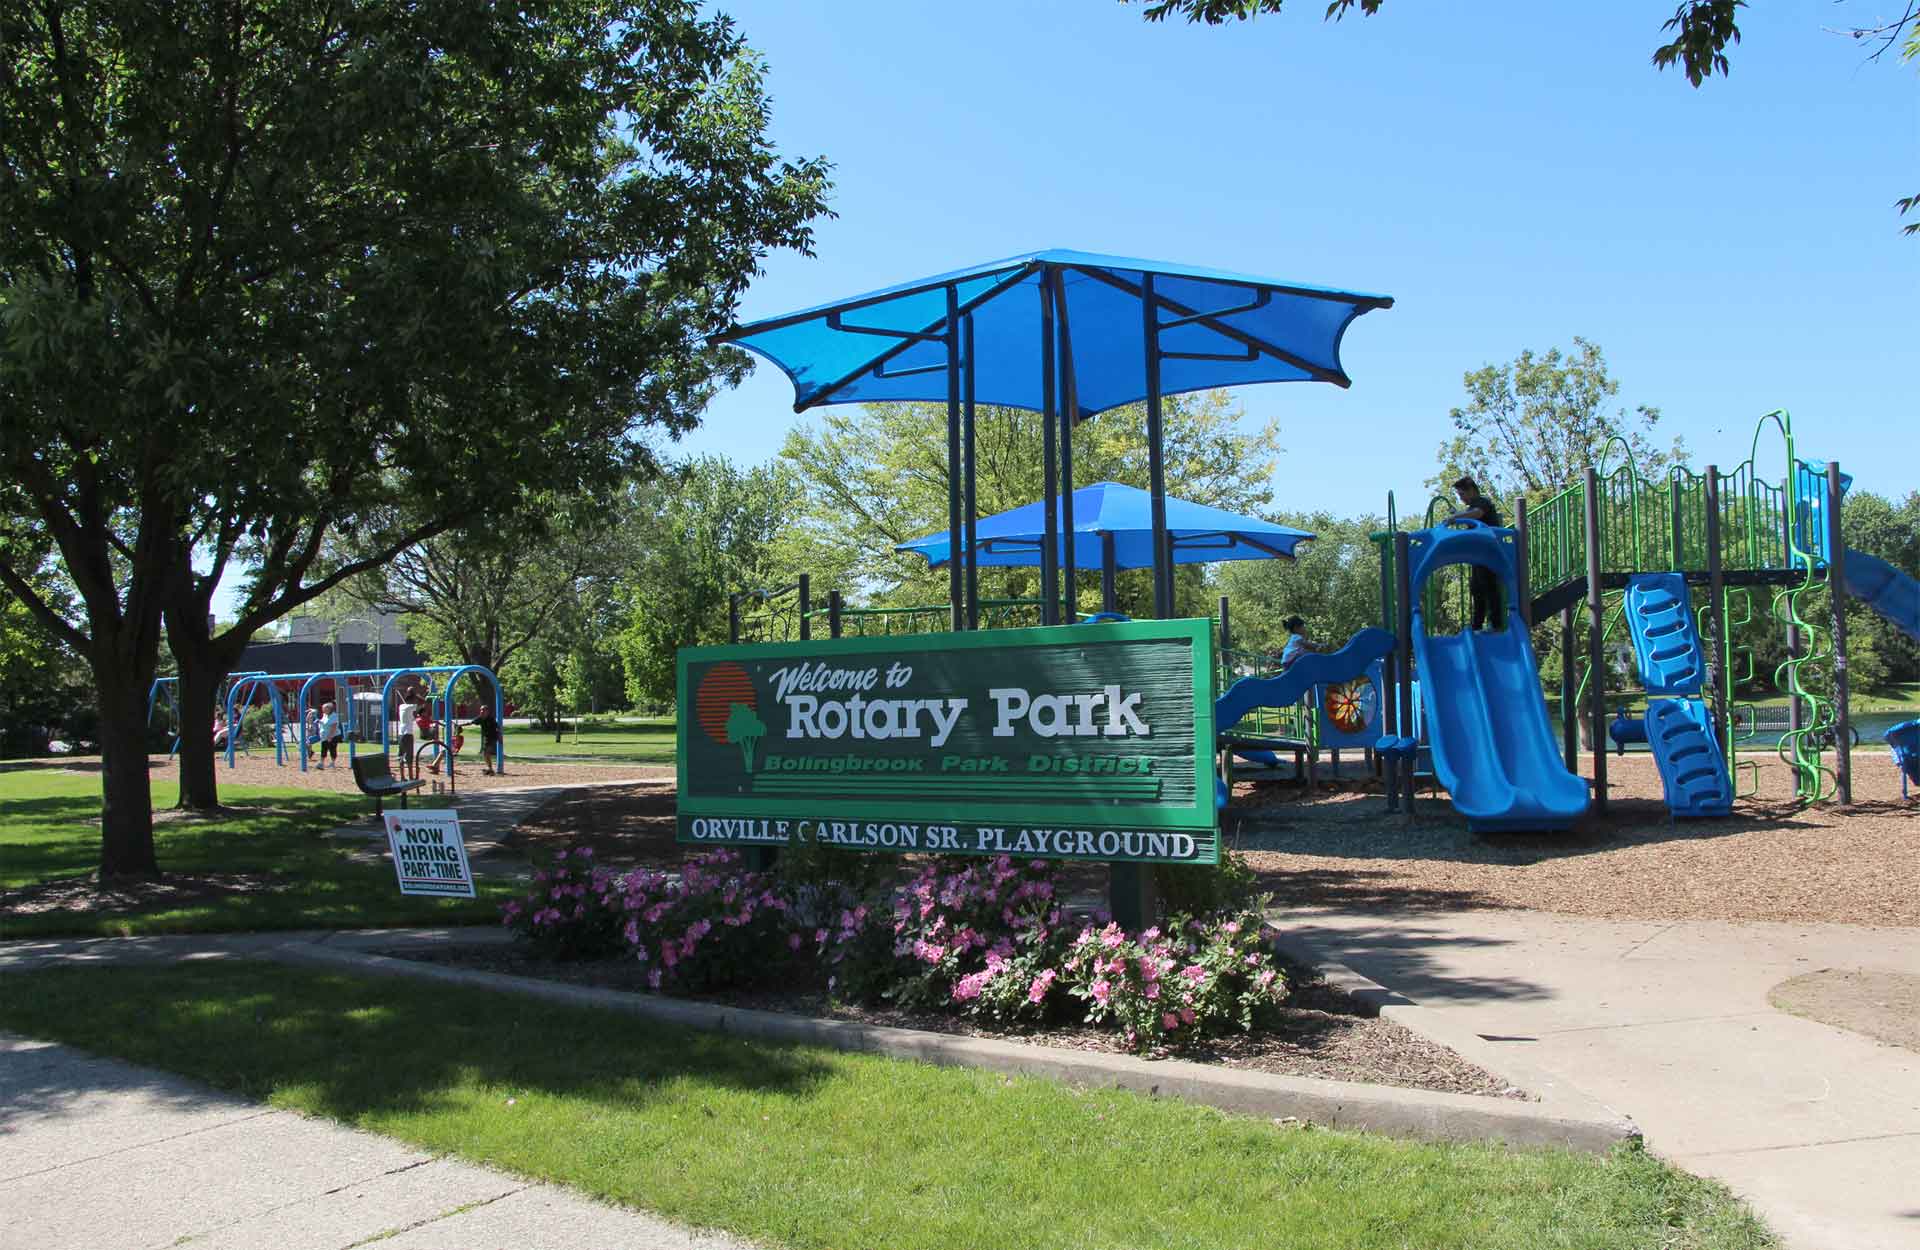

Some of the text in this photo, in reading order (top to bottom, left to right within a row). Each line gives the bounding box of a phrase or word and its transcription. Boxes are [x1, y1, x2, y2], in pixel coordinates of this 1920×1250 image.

[769, 661, 913, 704] Welcome to
[785, 685, 1150, 747] Rotary Park
[764, 754, 1151, 773] Bolingbrook Park District
[404, 828, 443, 844] NOW
[691, 818, 790, 842] ORVILLE
[925, 826, 968, 849] SR.
[976, 827, 1195, 857] PLAYGROUND
[400, 845, 459, 861] HIRING
[403, 862, 462, 879] PART-TIME
